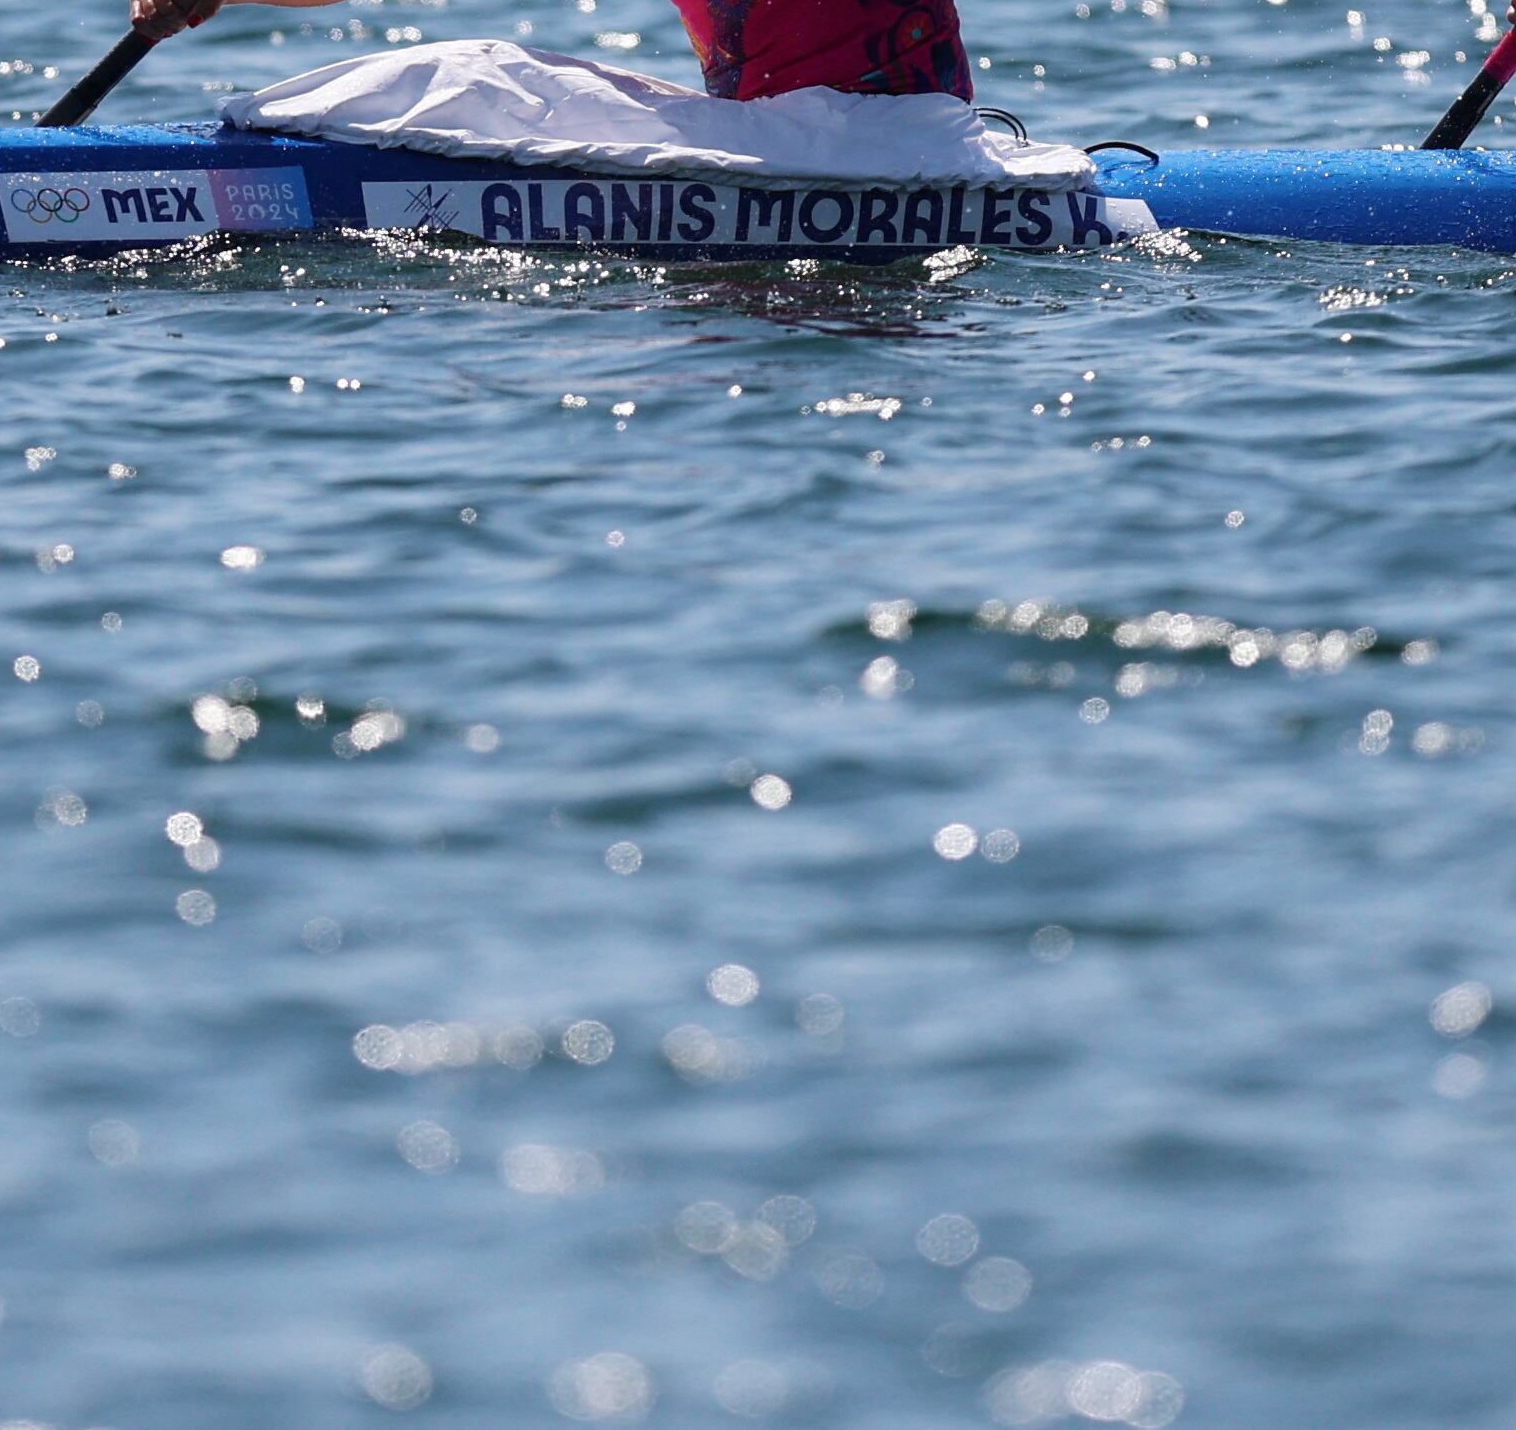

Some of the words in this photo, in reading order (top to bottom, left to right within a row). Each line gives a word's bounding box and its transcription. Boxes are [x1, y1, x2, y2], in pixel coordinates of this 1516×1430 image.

[101, 187, 205, 224] MEX
[225, 183, 294, 201] PARIS
[231, 203, 299, 221] 2024
[481, 182, 716, 242] ALANIS
[734, 185, 1053, 246] MORALES
